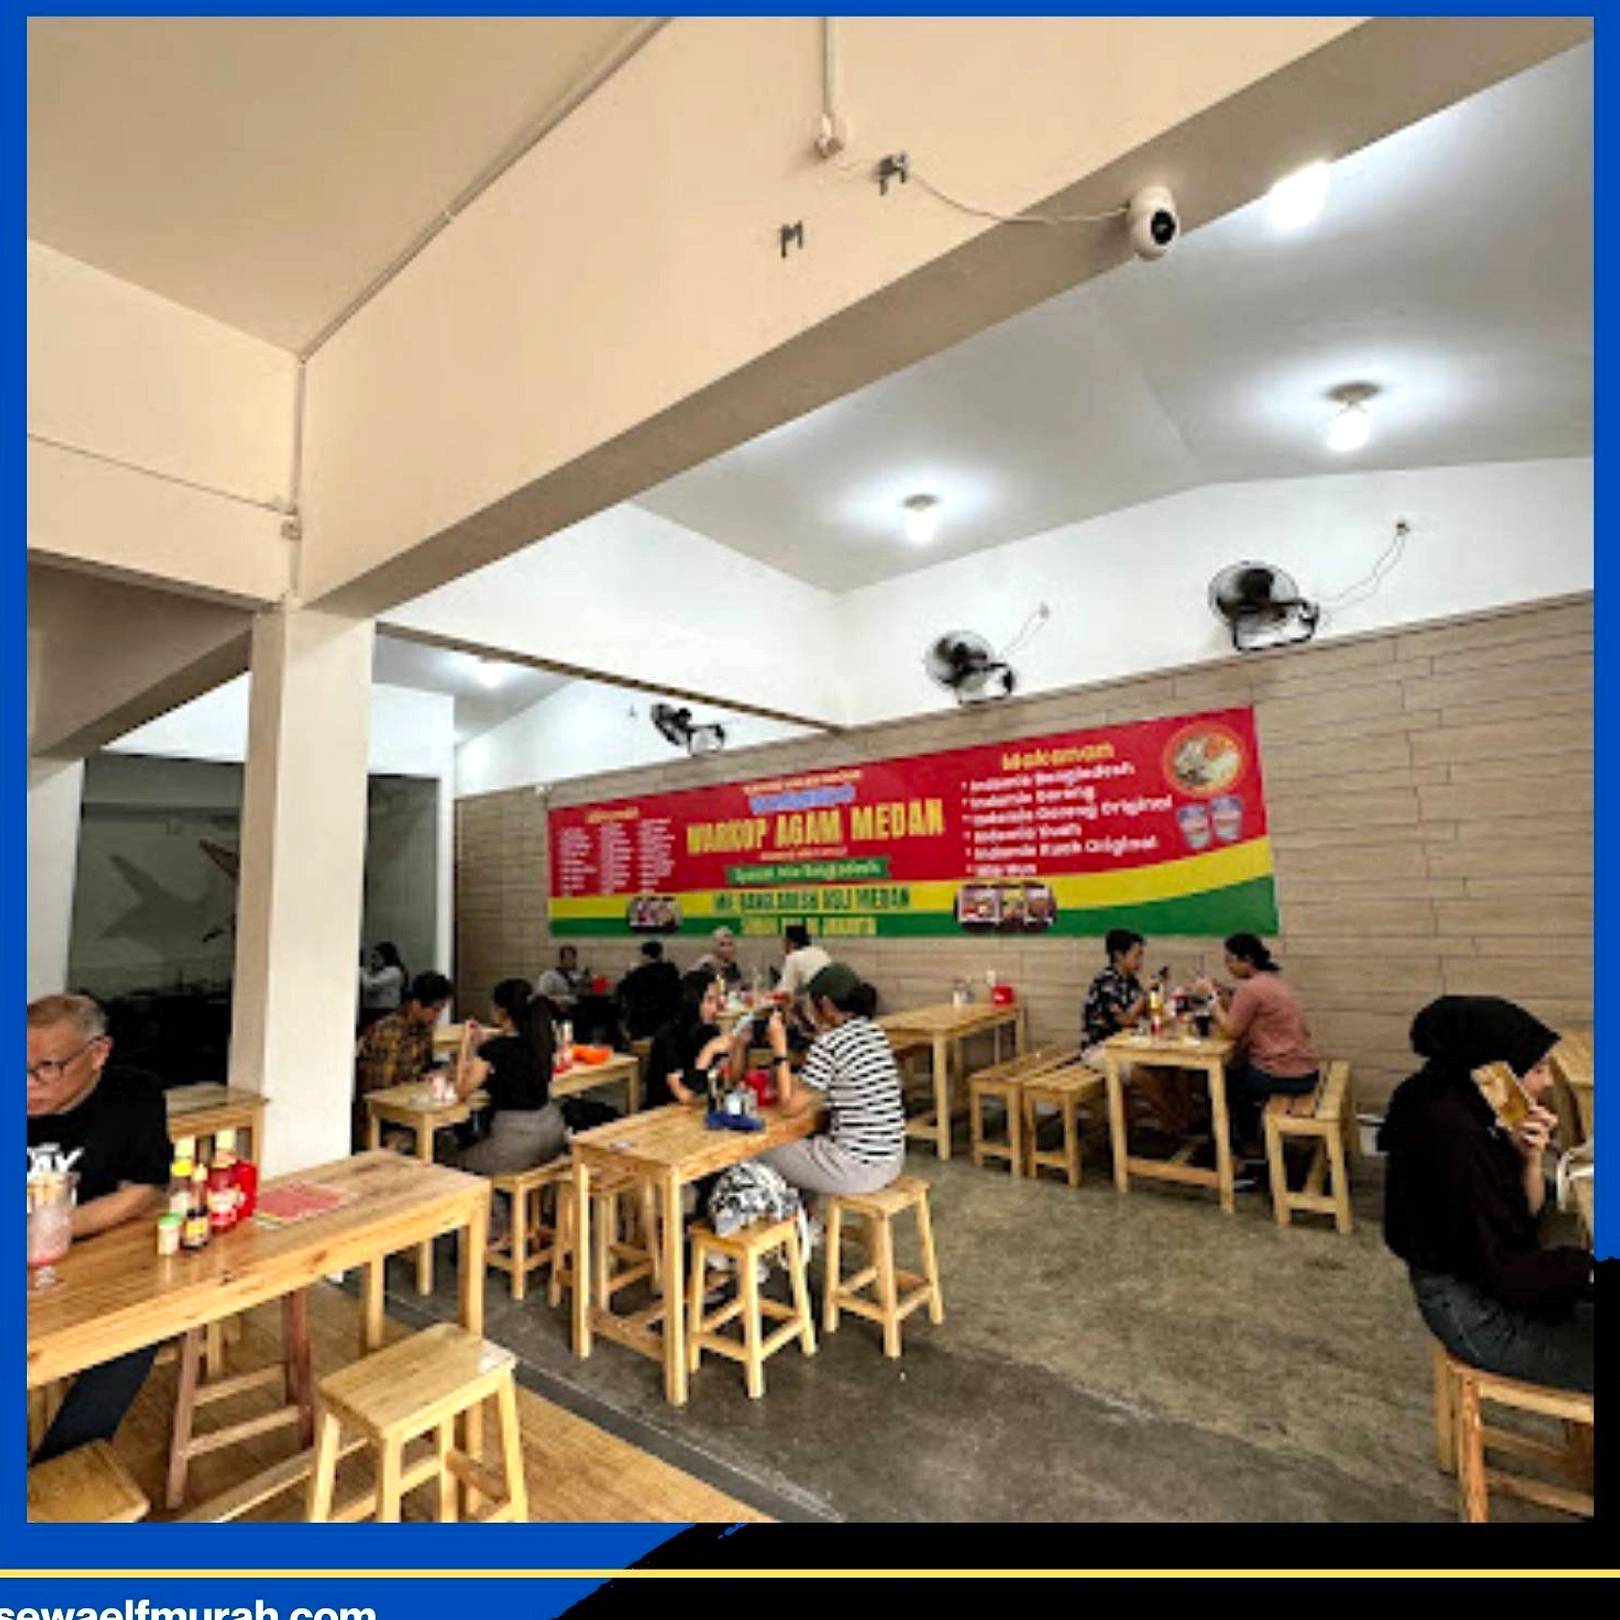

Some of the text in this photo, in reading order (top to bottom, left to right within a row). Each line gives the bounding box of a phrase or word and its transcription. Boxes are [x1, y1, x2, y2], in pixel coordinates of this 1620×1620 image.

[1002, 743, 1114, 769] Makanan
[687, 820, 766, 854] WARKOP
[776, 811, 842, 847] AGAM
[852, 798, 943, 840] MEDAN
